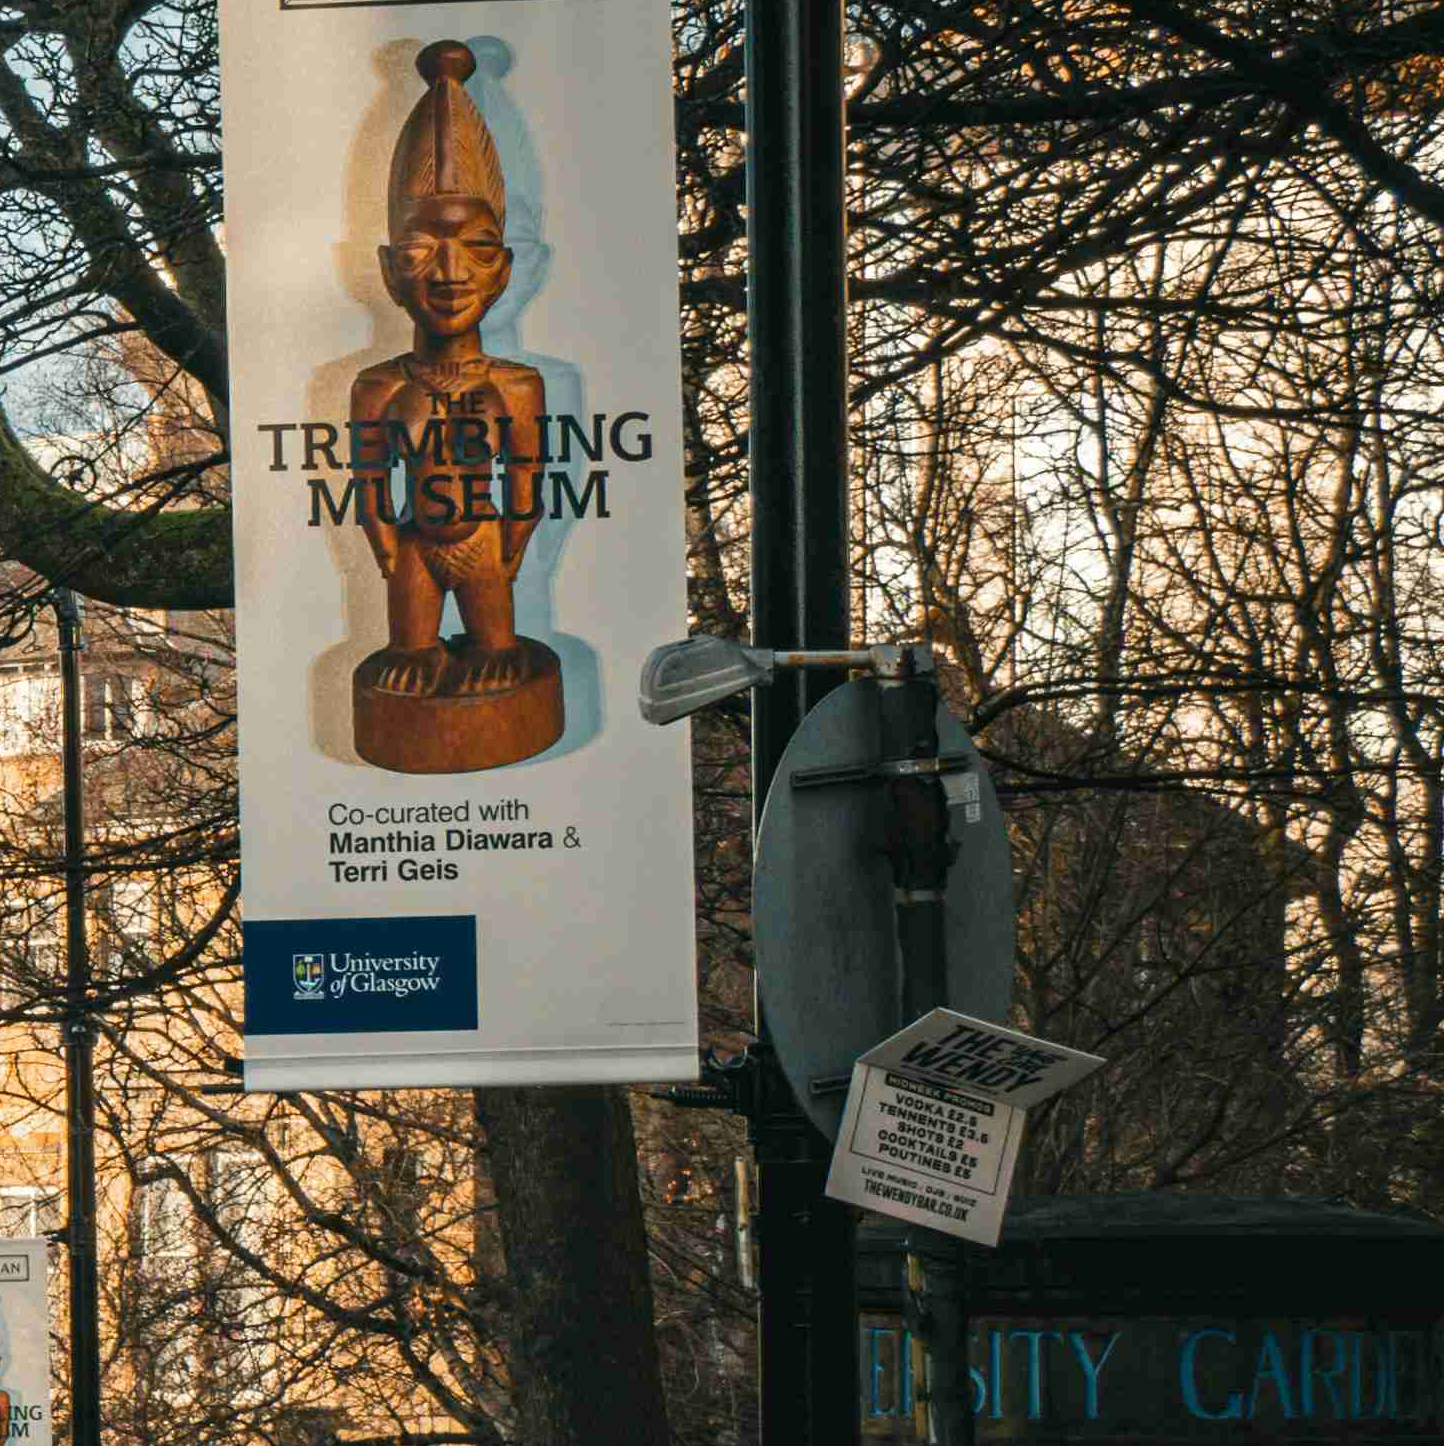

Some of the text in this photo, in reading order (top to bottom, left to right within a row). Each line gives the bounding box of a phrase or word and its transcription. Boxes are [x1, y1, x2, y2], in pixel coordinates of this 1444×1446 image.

[425, 391, 486, 416] THE
[256, 411, 653, 472] TREMBLING
[306, 469, 611, 527] MUSEUM
[328, 799, 530, 826] Co-curated with
[329, 826, 582, 855] Manthia Diawara &
[328, 858, 460, 883] Terri Geis
[329, 950, 442, 976] University
[329, 971, 442, 1000] of Glasgow
[937, 1024, 1016, 1059] THE
[901, 1041, 1043, 1093] WENDY
[878, 1101, 956, 1133] TENNENTS
[895, 1093, 944, 1116] VODKA
[878, 1129, 958, 1162] COCKTAILS
[897, 1121, 965, 1150] SHOTS £2
[878, 1143, 952, 1174] POUTINES
